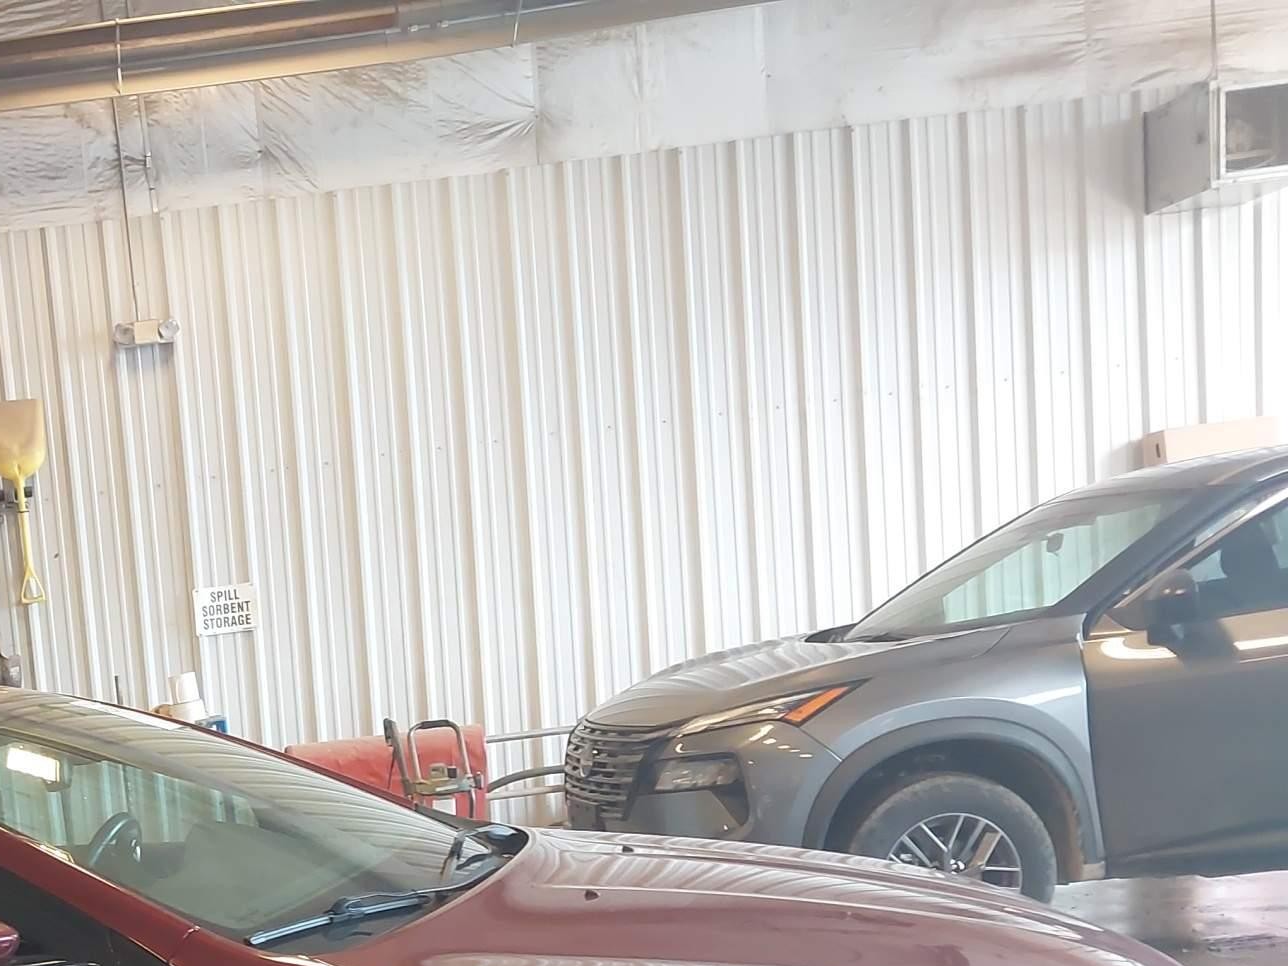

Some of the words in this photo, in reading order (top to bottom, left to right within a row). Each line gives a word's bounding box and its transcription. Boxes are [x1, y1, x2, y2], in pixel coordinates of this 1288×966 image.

[210, 589, 240, 603] SPILL
[202, 601, 250, 617] SORBENT
[203, 614, 252, 630] STORAGE
